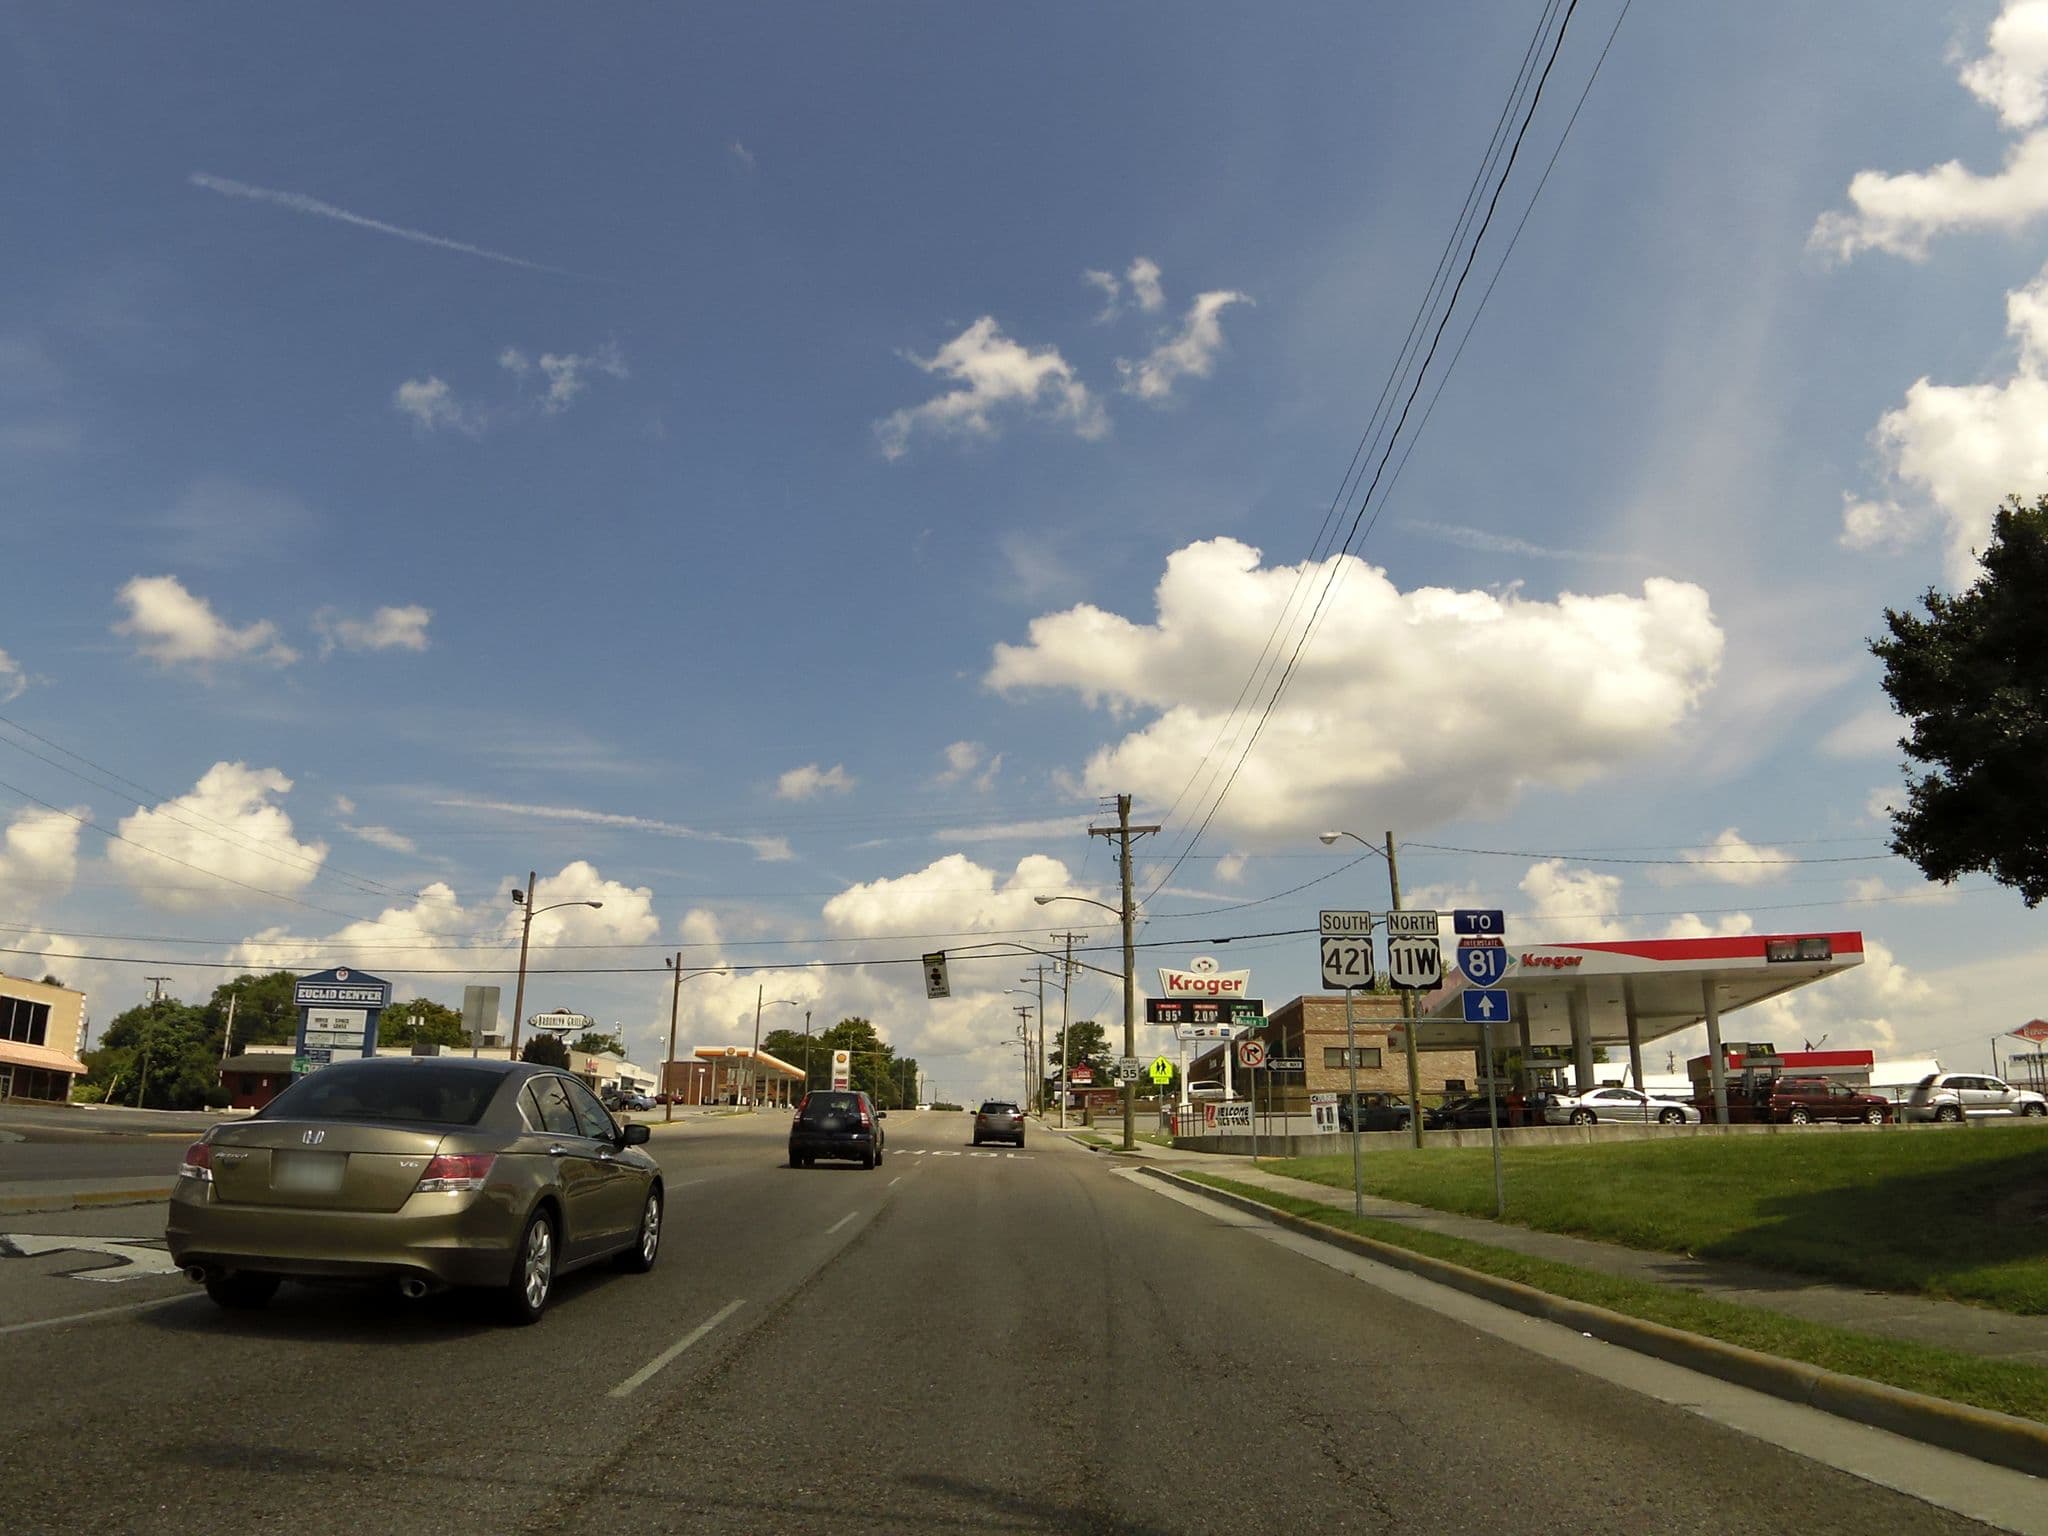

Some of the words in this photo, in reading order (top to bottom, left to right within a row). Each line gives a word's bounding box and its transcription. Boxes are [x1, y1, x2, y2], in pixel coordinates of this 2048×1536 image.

[1323, 914, 1369, 931] SOUTH
[1390, 914, 1436, 930] NORTH
[1467, 914, 1492, 930] TO
[1462, 939, 1499, 948] INTERSTATE
[1325, 948, 1370, 976] 421
[1393, 948, 1437, 976] 11W
[1468, 950, 1496, 977] 81
[1520, 952, 1583, 970] Kroger
[1168, 974, 1243, 996] Kroger
[297, 988, 337, 1000] EUCLID
[338, 989, 382, 1001] CENTER
[1122, 1069, 1138, 1079] 35
[399, 1160, 420, 1169] V6
